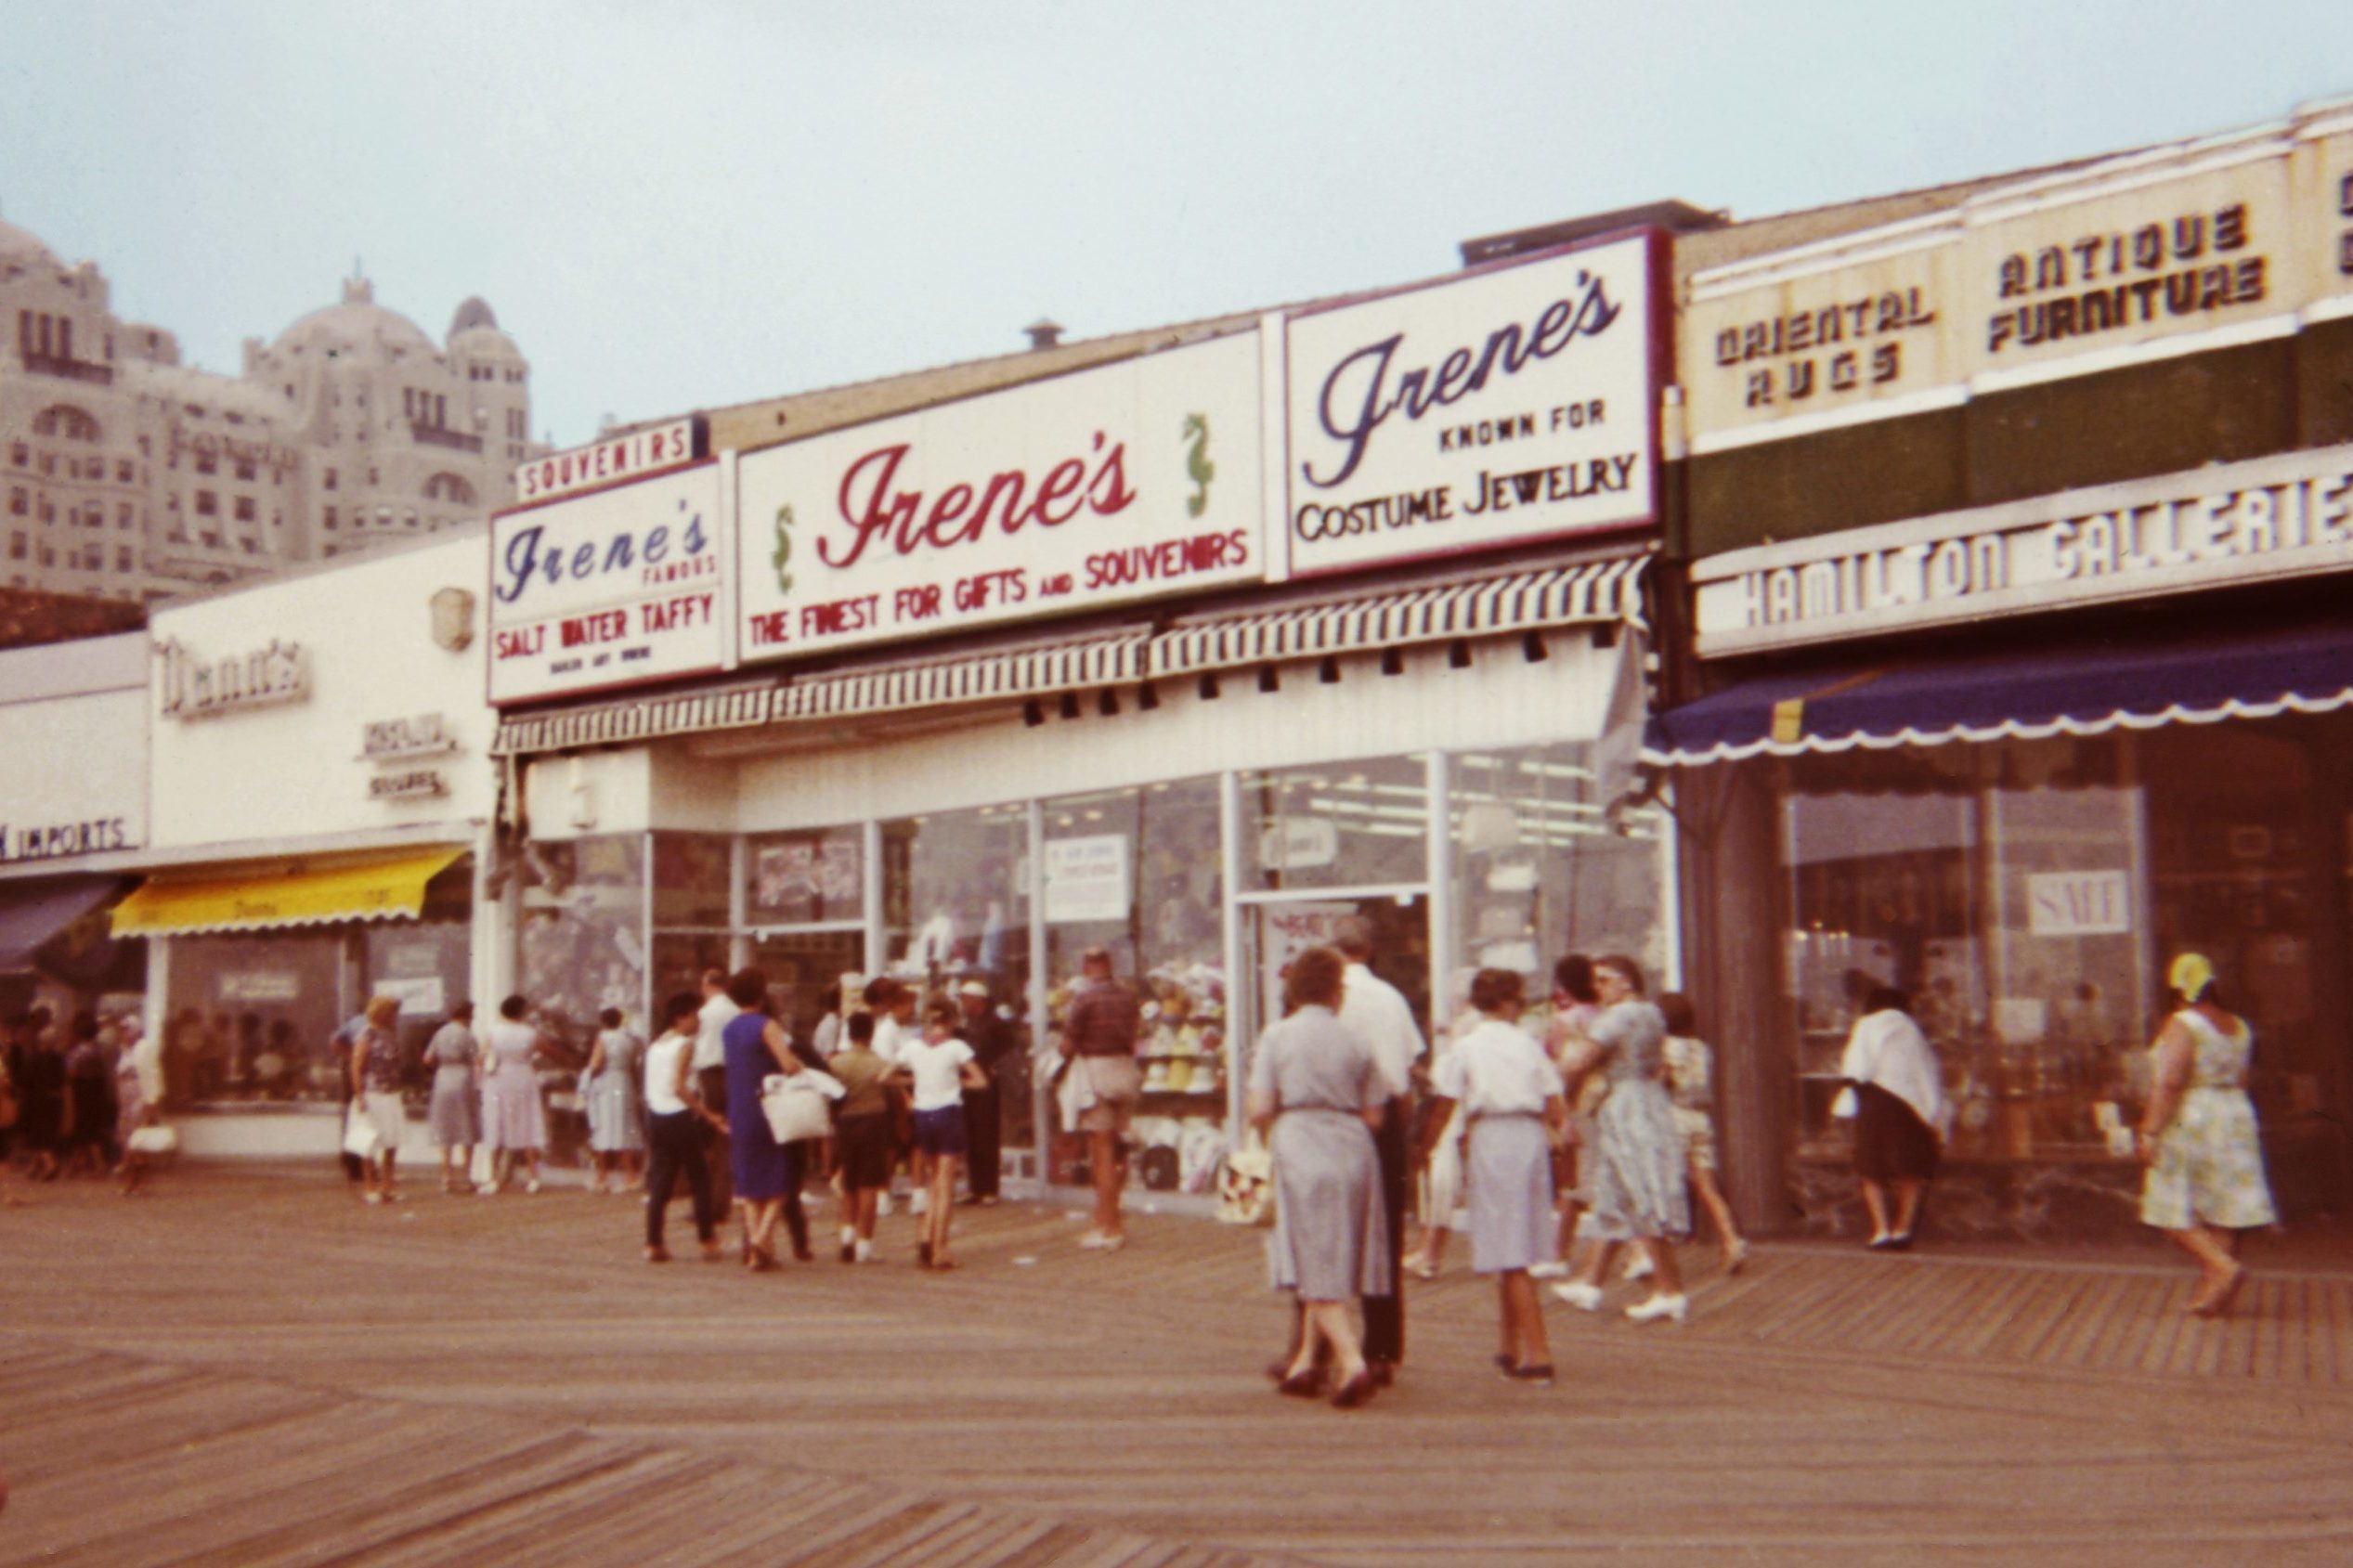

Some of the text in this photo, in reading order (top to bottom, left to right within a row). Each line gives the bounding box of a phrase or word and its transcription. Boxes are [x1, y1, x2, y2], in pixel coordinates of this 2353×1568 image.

[1999, 201, 2249, 299] ANTIQUE
[1715, 285, 1938, 367] ORIENTAL
[1987, 255, 2268, 354] FURNITURE
[1301, 268, 1622, 489] Irene's
[1746, 341, 1901, 408] RUGS
[525, 427, 686, 496] SOUVENIRS
[1438, 397, 1606, 454] KNOWN FOR
[816, 430, 1137, 570] Irene's
[1295, 452, 1638, 544] COSTUME JEWELRY
[495, 499, 708, 603] Irene's
[643, 554, 716, 586] FAMOUS
[748, 527, 1249, 648] THE FINEST FOR GIFTS AND SOUVENIRS
[1740, 532, 2013, 628] HAMILTON
[496, 623, 547, 661] SALT
[560, 609, 628, 649] WATER
[641, 591, 714, 633] TAFFY
[17, 817, 126, 860] IMPORTS
